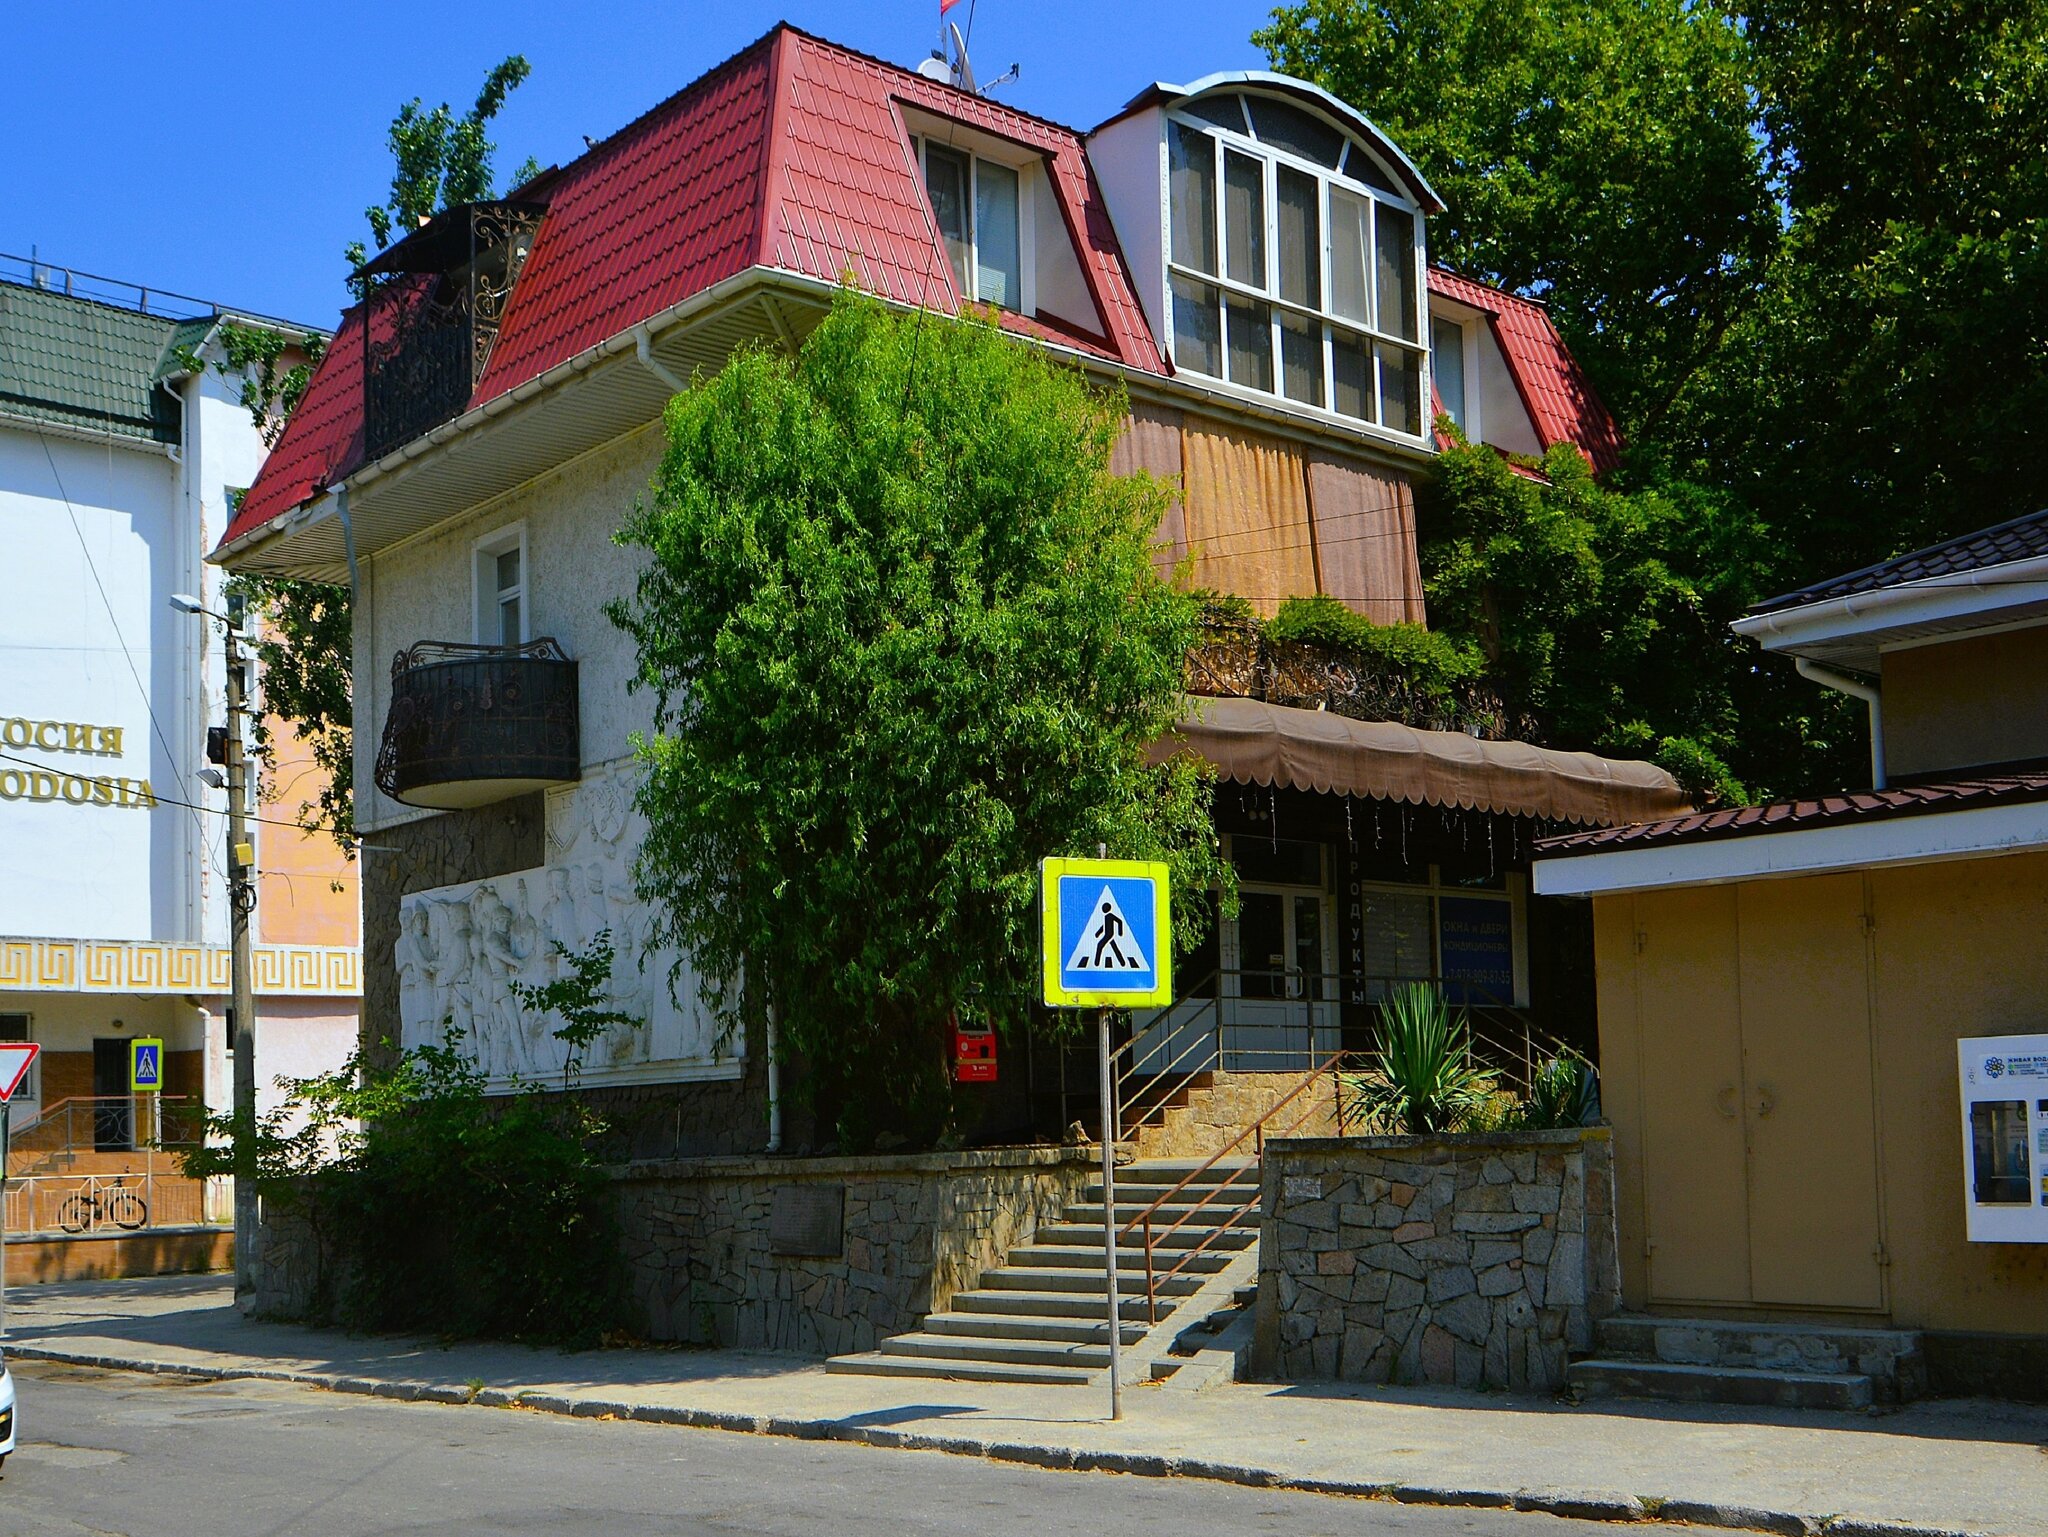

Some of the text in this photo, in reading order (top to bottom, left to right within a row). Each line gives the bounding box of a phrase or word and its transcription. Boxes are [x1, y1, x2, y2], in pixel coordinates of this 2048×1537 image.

[0, 717, 124, 756] ОСИЯ
[1348, 840, 1365, 1004] ПРОДУКТЫ
[1443, 920, 1469, 933] ОКНА
[1480, 922, 1508, 935] ДВЕРИ
[1444, 940, 1508, 953] КОНДИЦИОНЕРЫ
